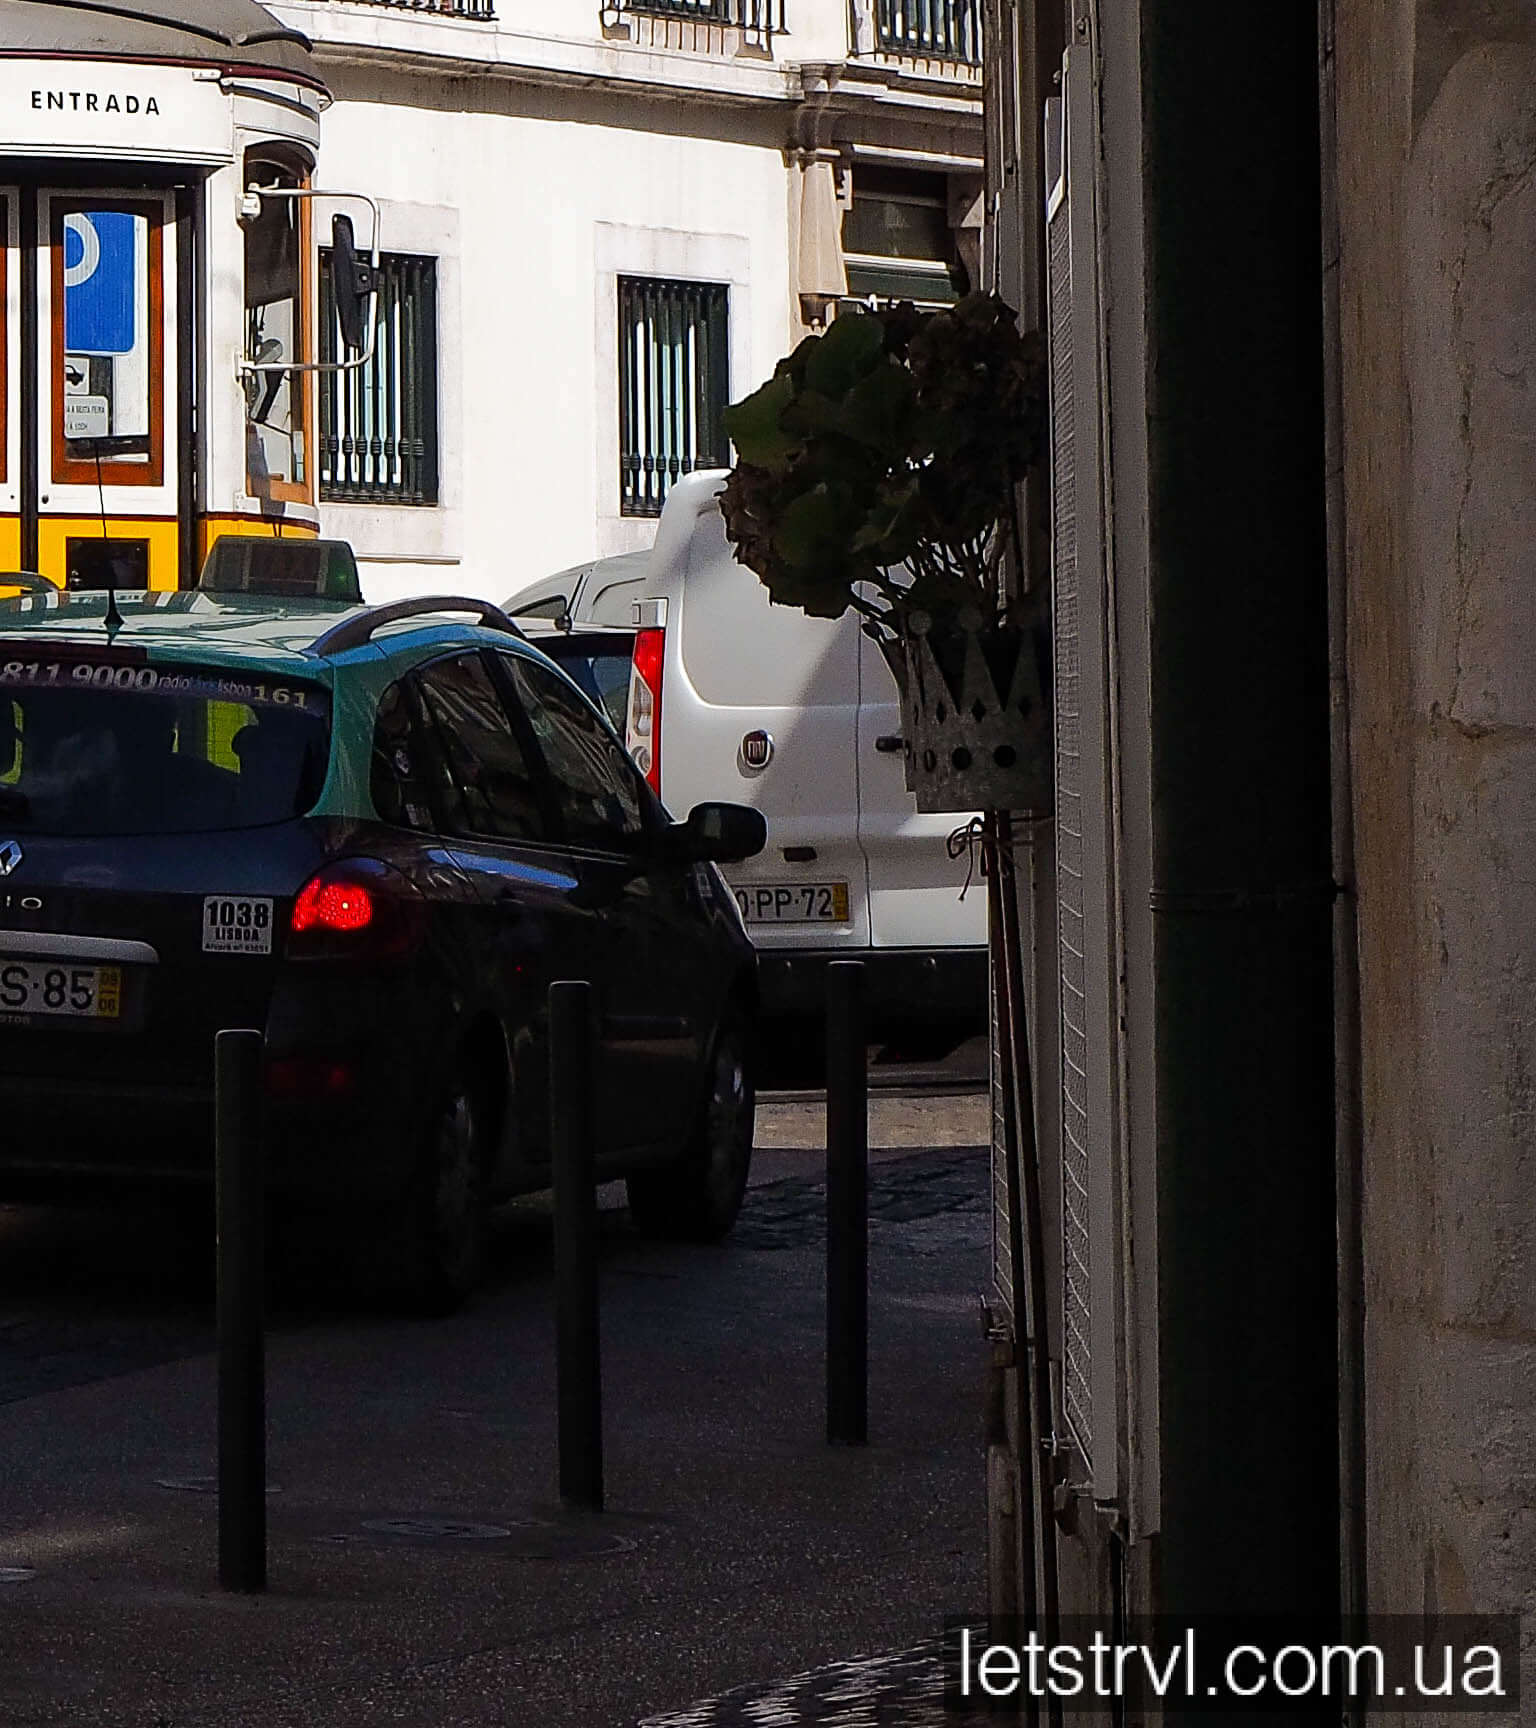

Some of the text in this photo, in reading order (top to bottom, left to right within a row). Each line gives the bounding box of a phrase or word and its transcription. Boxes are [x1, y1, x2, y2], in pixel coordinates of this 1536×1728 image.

[31, 90, 160, 115] ENTRADA
[0, 662, 60, 683] 811
[72, 664, 158, 690] 9000
[253, 685, 309, 710] 161
[207, 901, 269, 928] 1038
